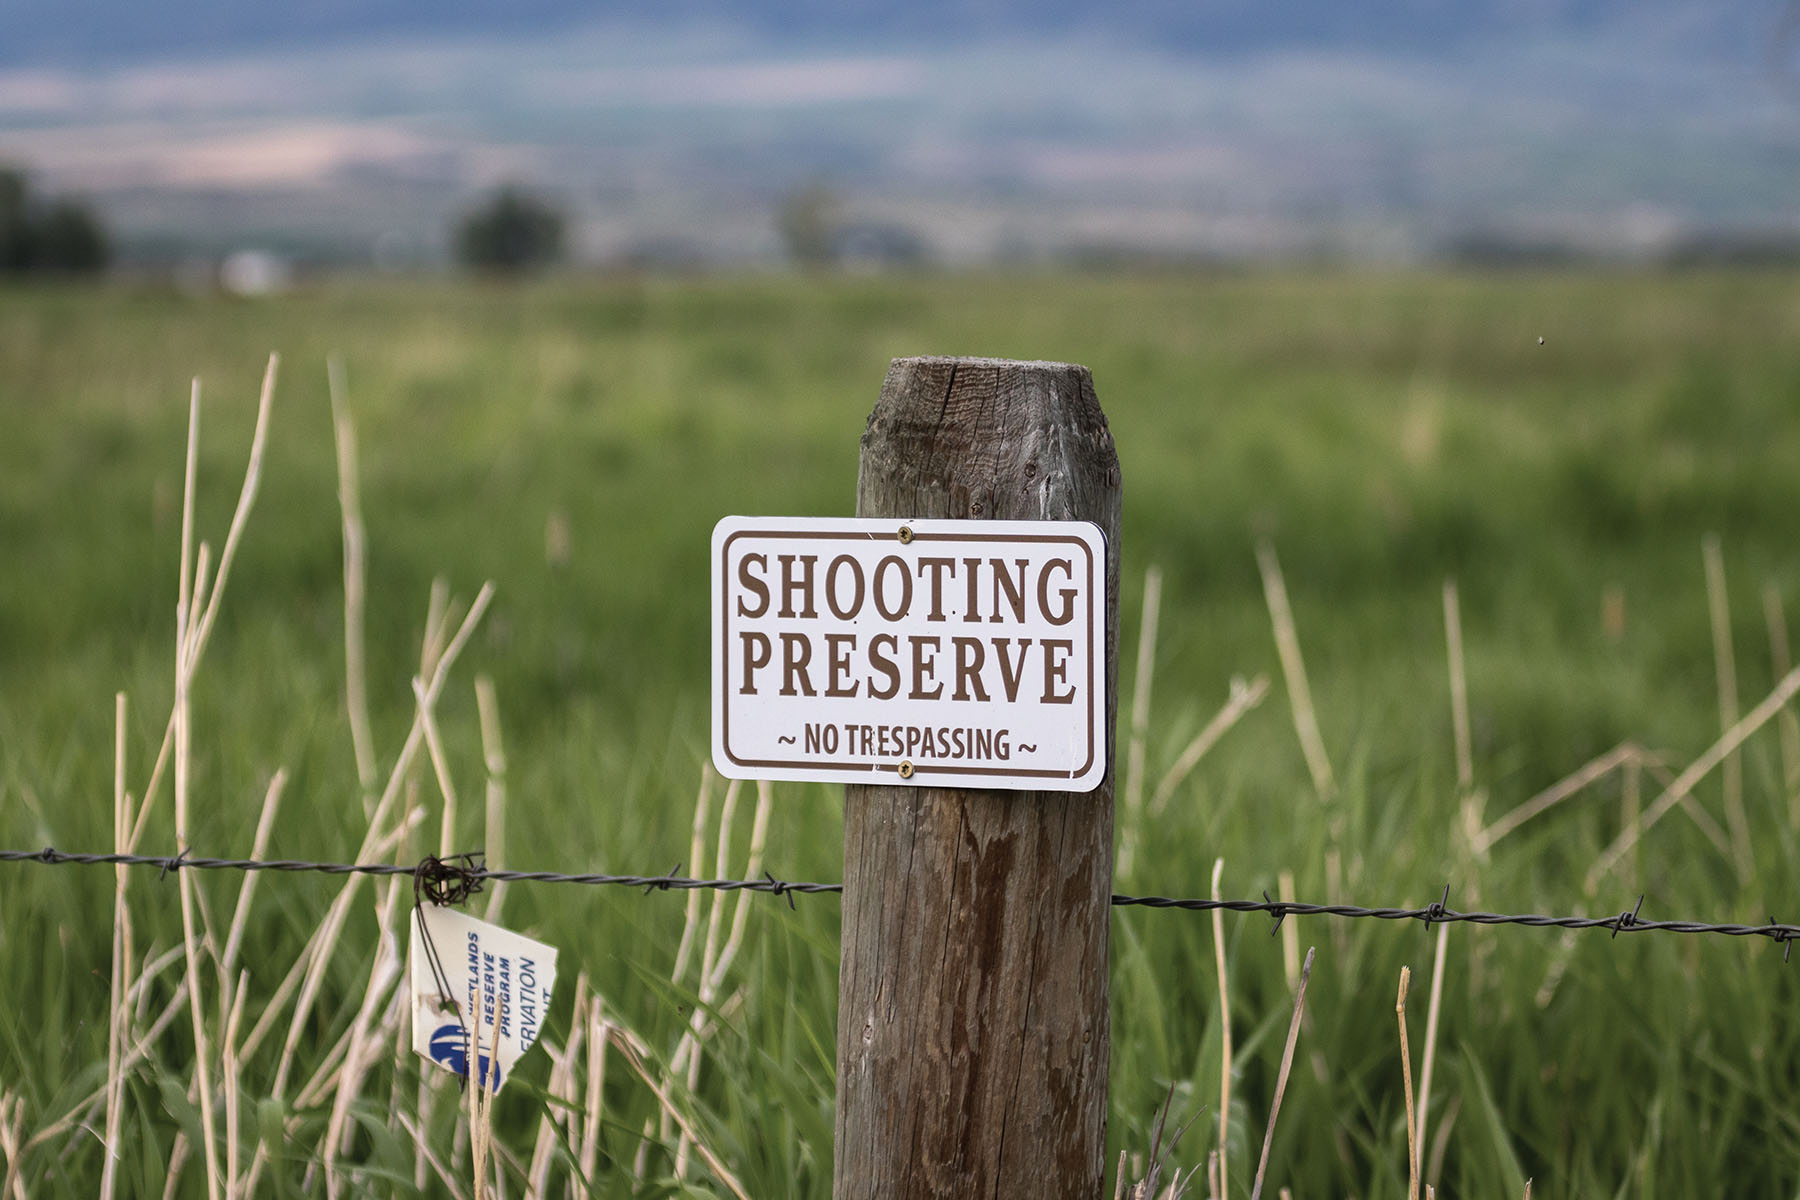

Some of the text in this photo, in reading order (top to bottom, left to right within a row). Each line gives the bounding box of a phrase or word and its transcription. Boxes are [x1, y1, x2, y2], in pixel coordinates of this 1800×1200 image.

[737, 552, 1078, 626] SHOOTING
[738, 631, 1077, 704] PRESERVE
[804, 723, 838, 755] NO
[845, 724, 1010, 760] TRESPASSING
[484, 952, 495, 1026] RESERVE
[499, 957, 511, 1038] PROGRAM
